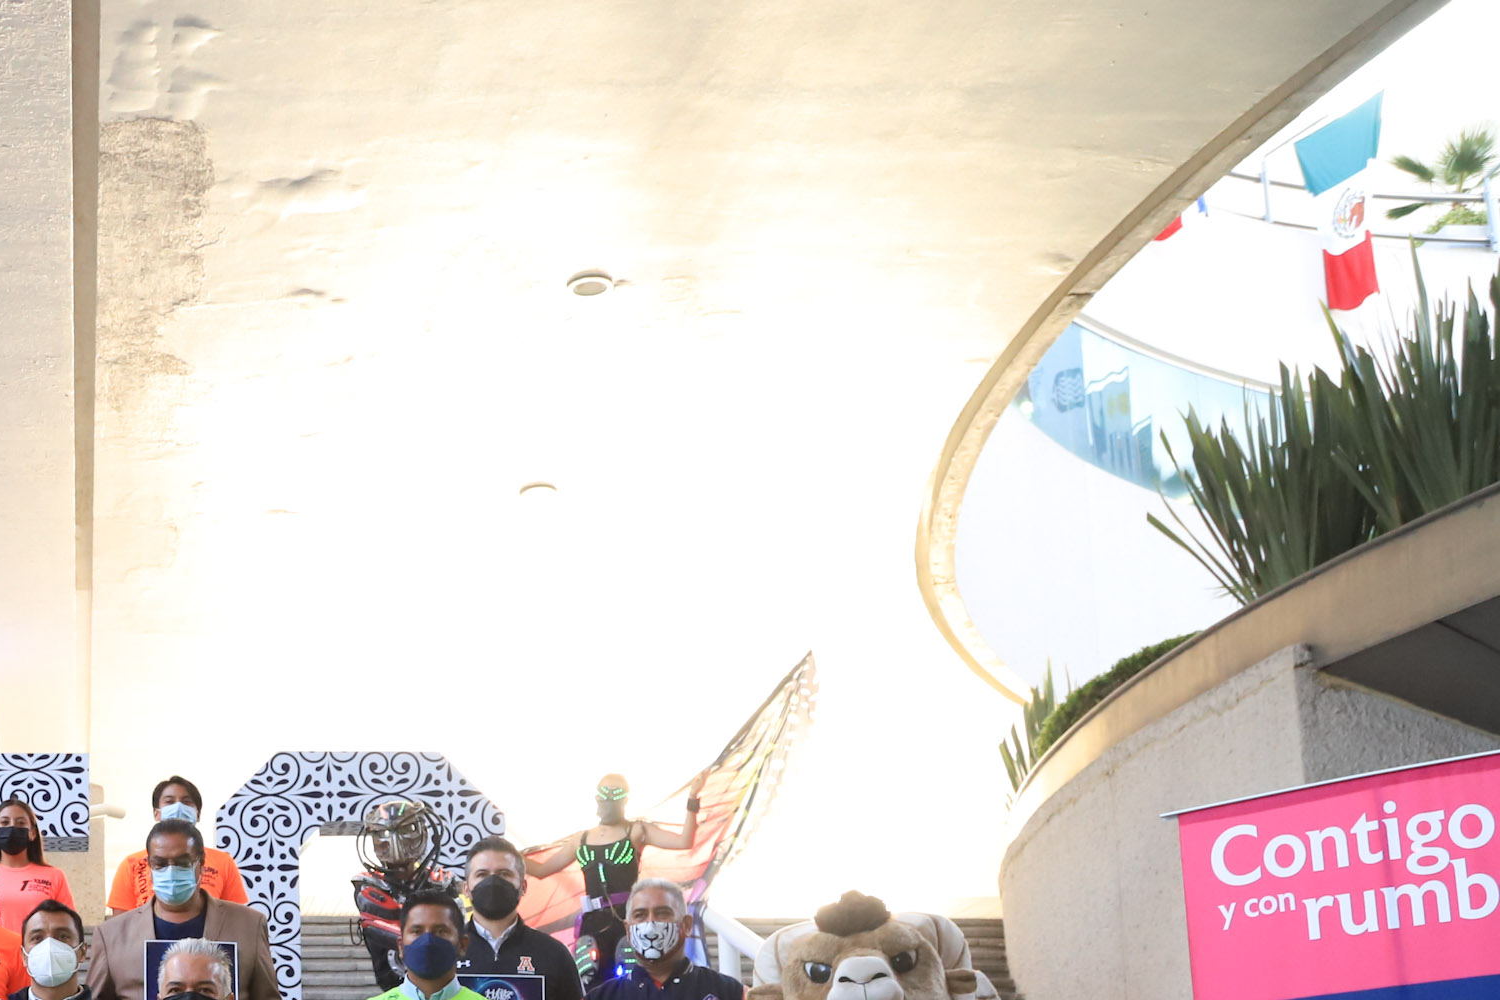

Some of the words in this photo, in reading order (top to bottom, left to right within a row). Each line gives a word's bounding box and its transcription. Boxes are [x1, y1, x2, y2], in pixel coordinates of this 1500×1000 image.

[1211, 801, 1495, 875] Contigo
[1218, 903, 1236, 930] y
[1244, 892, 1296, 917] con
